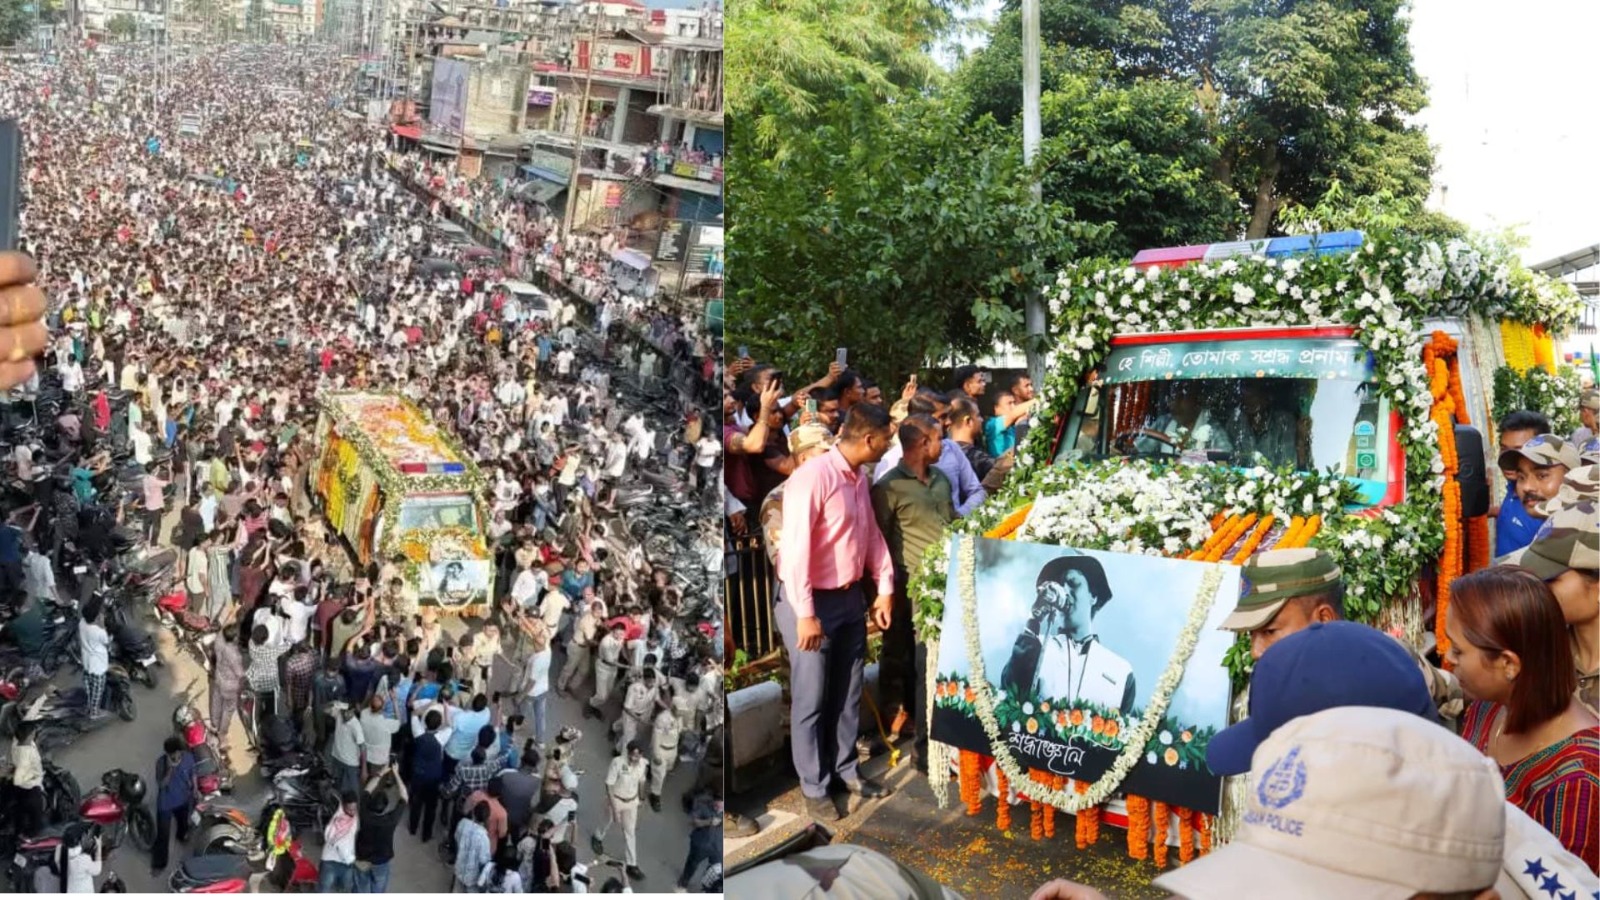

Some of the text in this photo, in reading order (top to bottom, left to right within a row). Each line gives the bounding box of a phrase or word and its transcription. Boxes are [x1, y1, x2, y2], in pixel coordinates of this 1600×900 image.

[1118, 356, 1136, 371] হে
[1182, 349, 1242, 367] তোমাক
[1250, 348, 1294, 365] সশ্রদ্ধ
[1008, 732, 1121, 775] শ্রদ্ধাঞ্জলি
[1267, 812, 1305, 837] POLICE
